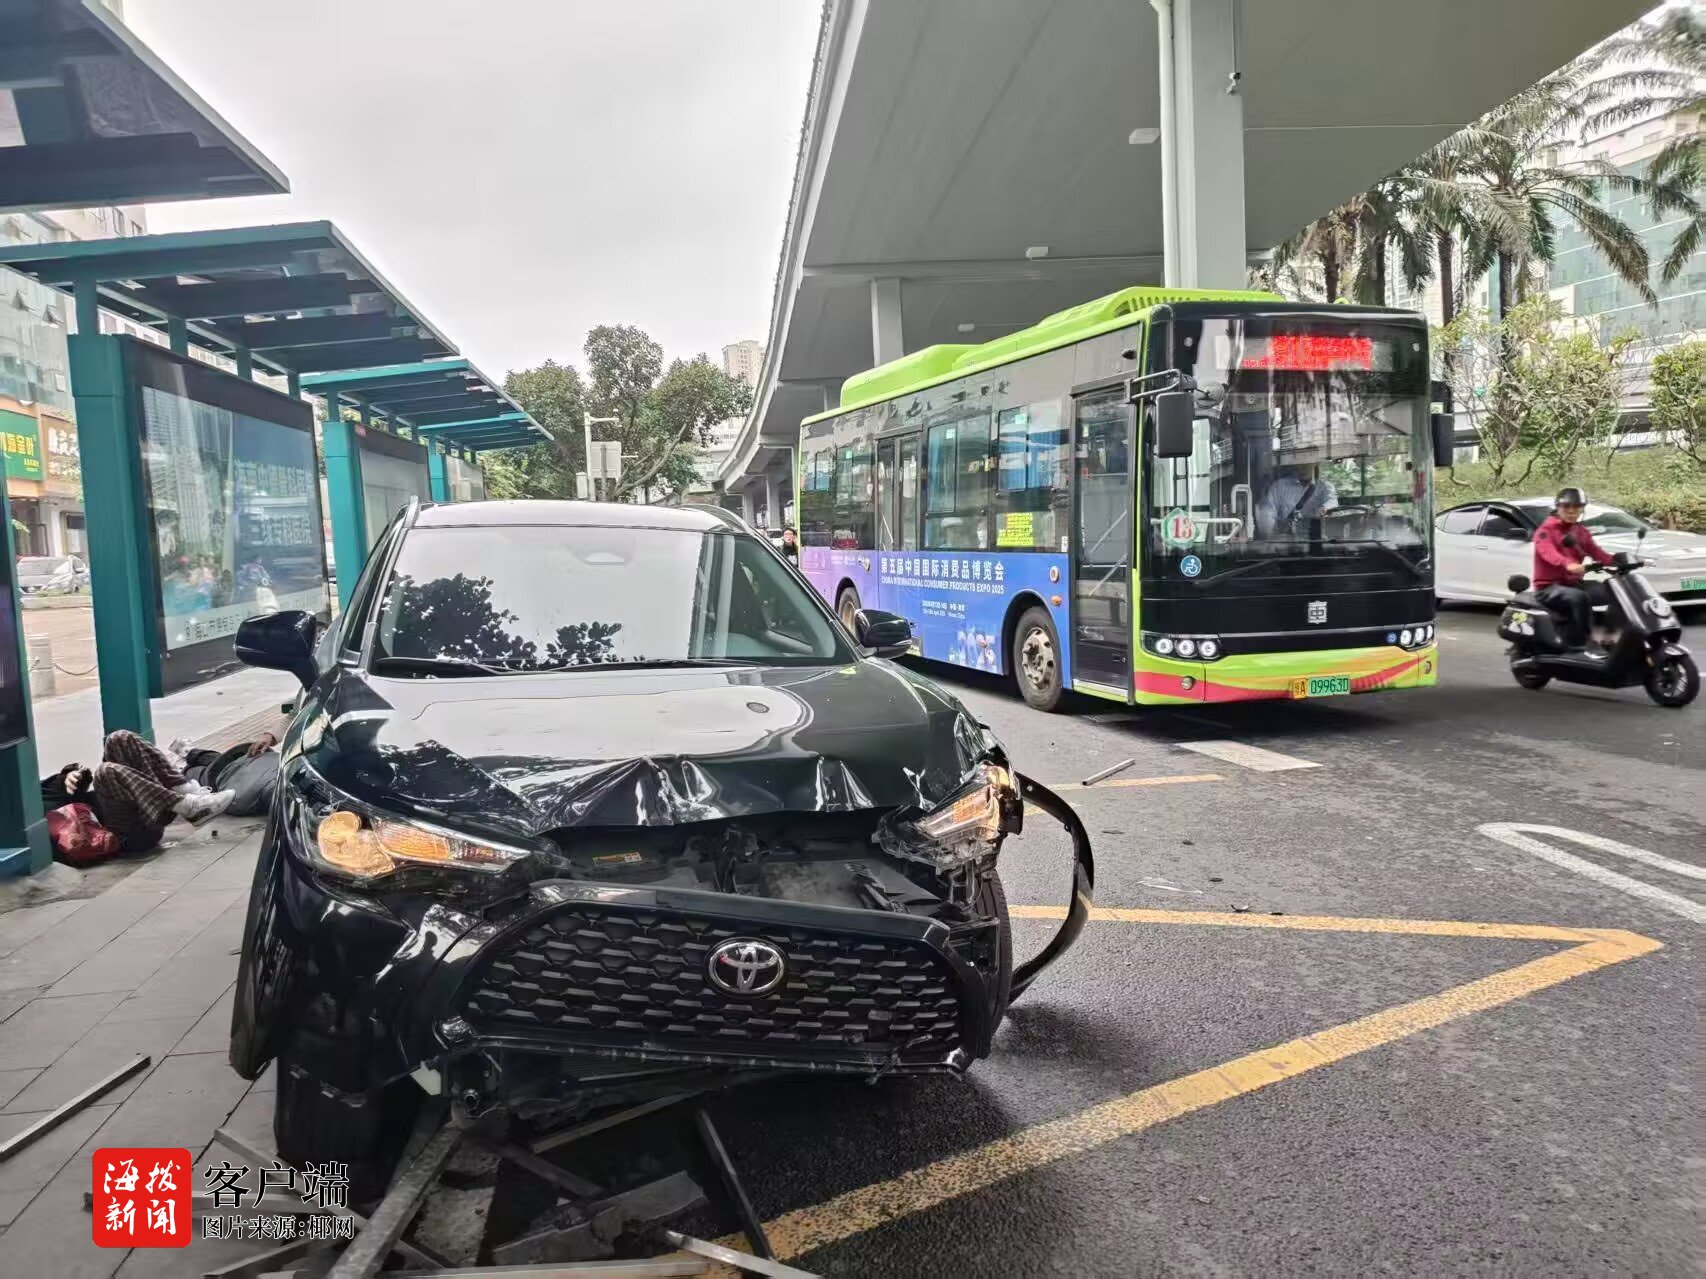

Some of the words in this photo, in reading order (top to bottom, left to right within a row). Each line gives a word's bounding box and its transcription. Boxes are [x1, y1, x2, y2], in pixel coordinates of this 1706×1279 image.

[881, 557, 1004, 581] 第五届中国国际消费品博览会
[977, 583, 990, 593] EXPO
[992, 584, 1005, 595] 2025
